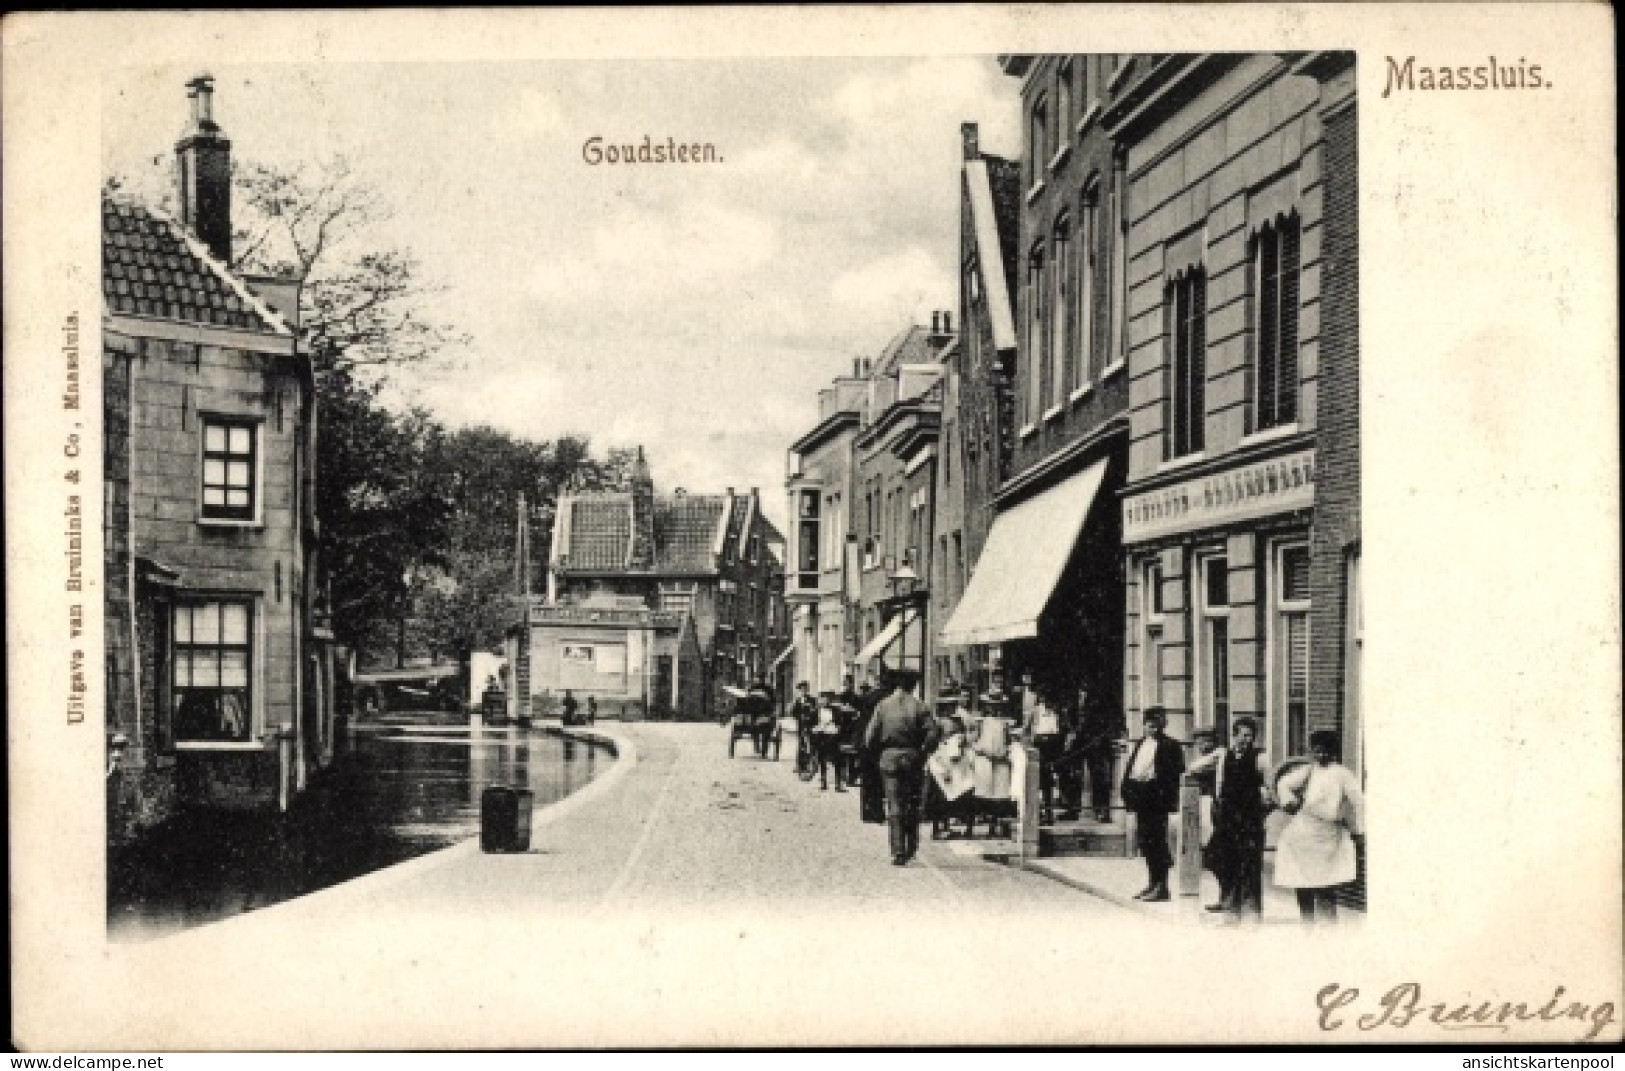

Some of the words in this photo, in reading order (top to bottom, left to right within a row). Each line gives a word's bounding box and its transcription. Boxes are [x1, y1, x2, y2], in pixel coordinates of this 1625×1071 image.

[1381, 56, 1553, 99] Maassluis.
[582, 134, 724, 166] Goudsteen.
[61, 310, 80, 410] Maassluis.
[64, 470, 81, 486] &
[69, 605, 83, 640] van
[67, 650, 88, 726] Uitgave
